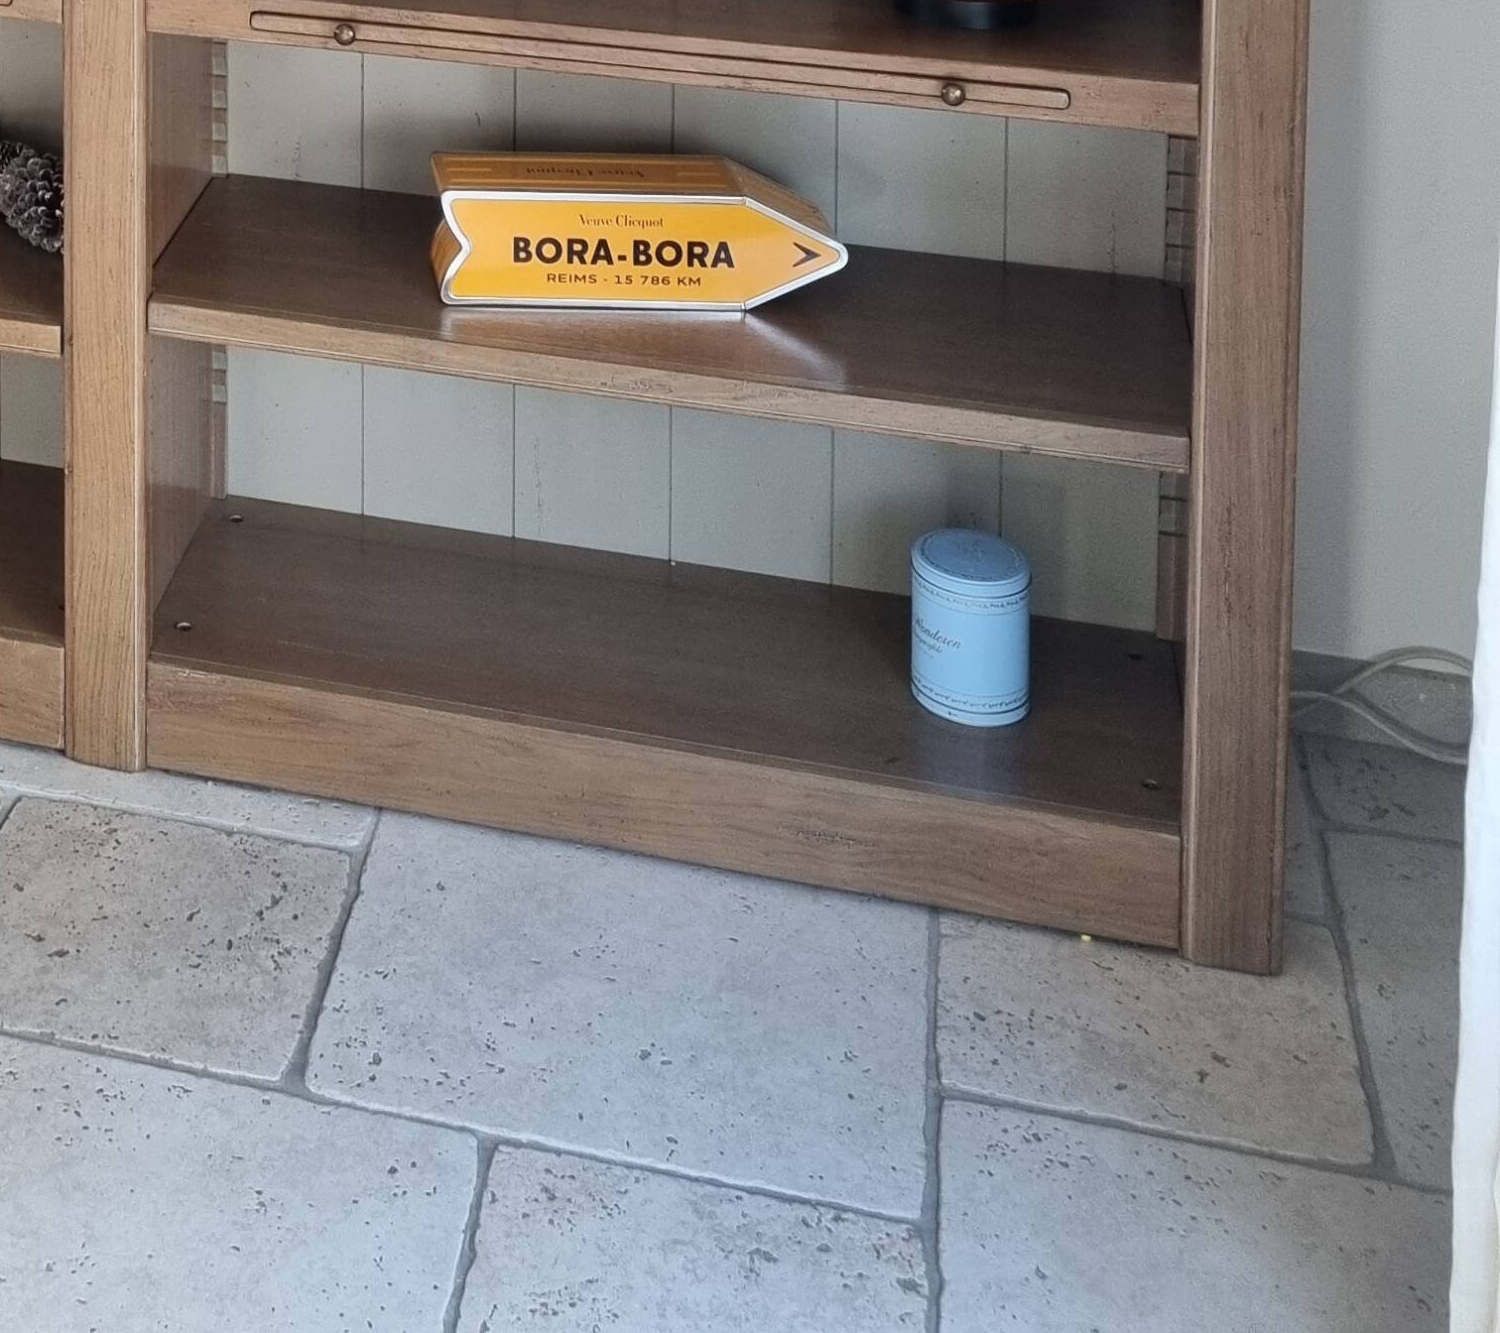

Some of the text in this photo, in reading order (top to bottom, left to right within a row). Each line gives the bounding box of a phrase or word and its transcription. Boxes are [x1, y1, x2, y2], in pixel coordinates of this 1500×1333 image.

[579, 214, 664, 230] Veuve Clicquot
[513, 236, 735, 269] BORA-BORA
[547, 273, 701, 287] REIMS 15 786 KM
